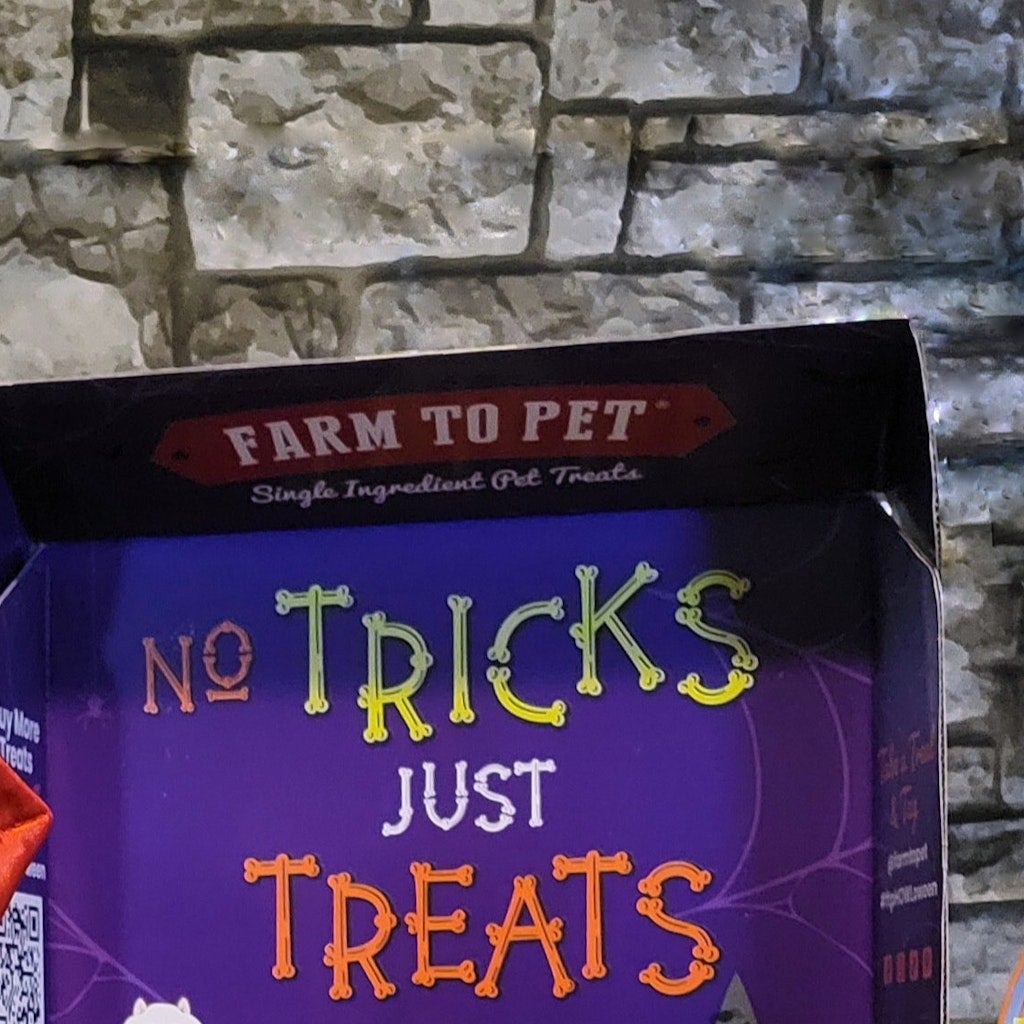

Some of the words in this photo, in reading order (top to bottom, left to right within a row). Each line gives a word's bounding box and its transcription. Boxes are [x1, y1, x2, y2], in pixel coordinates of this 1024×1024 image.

[223, 410, 403, 466] FARM
[421, 404, 500, 446] TO
[251, 481, 339, 507] Single
[343, 471, 483, 503] Ingredient
[492, 467, 543, 491] Pet
[549, 461, 643, 486] Treats
[275, 561, 759, 742] TRICKS
[13, 708, 41, 745] More
[381, 758, 556, 836] JUST
[244, 851, 720, 999] TREATS
